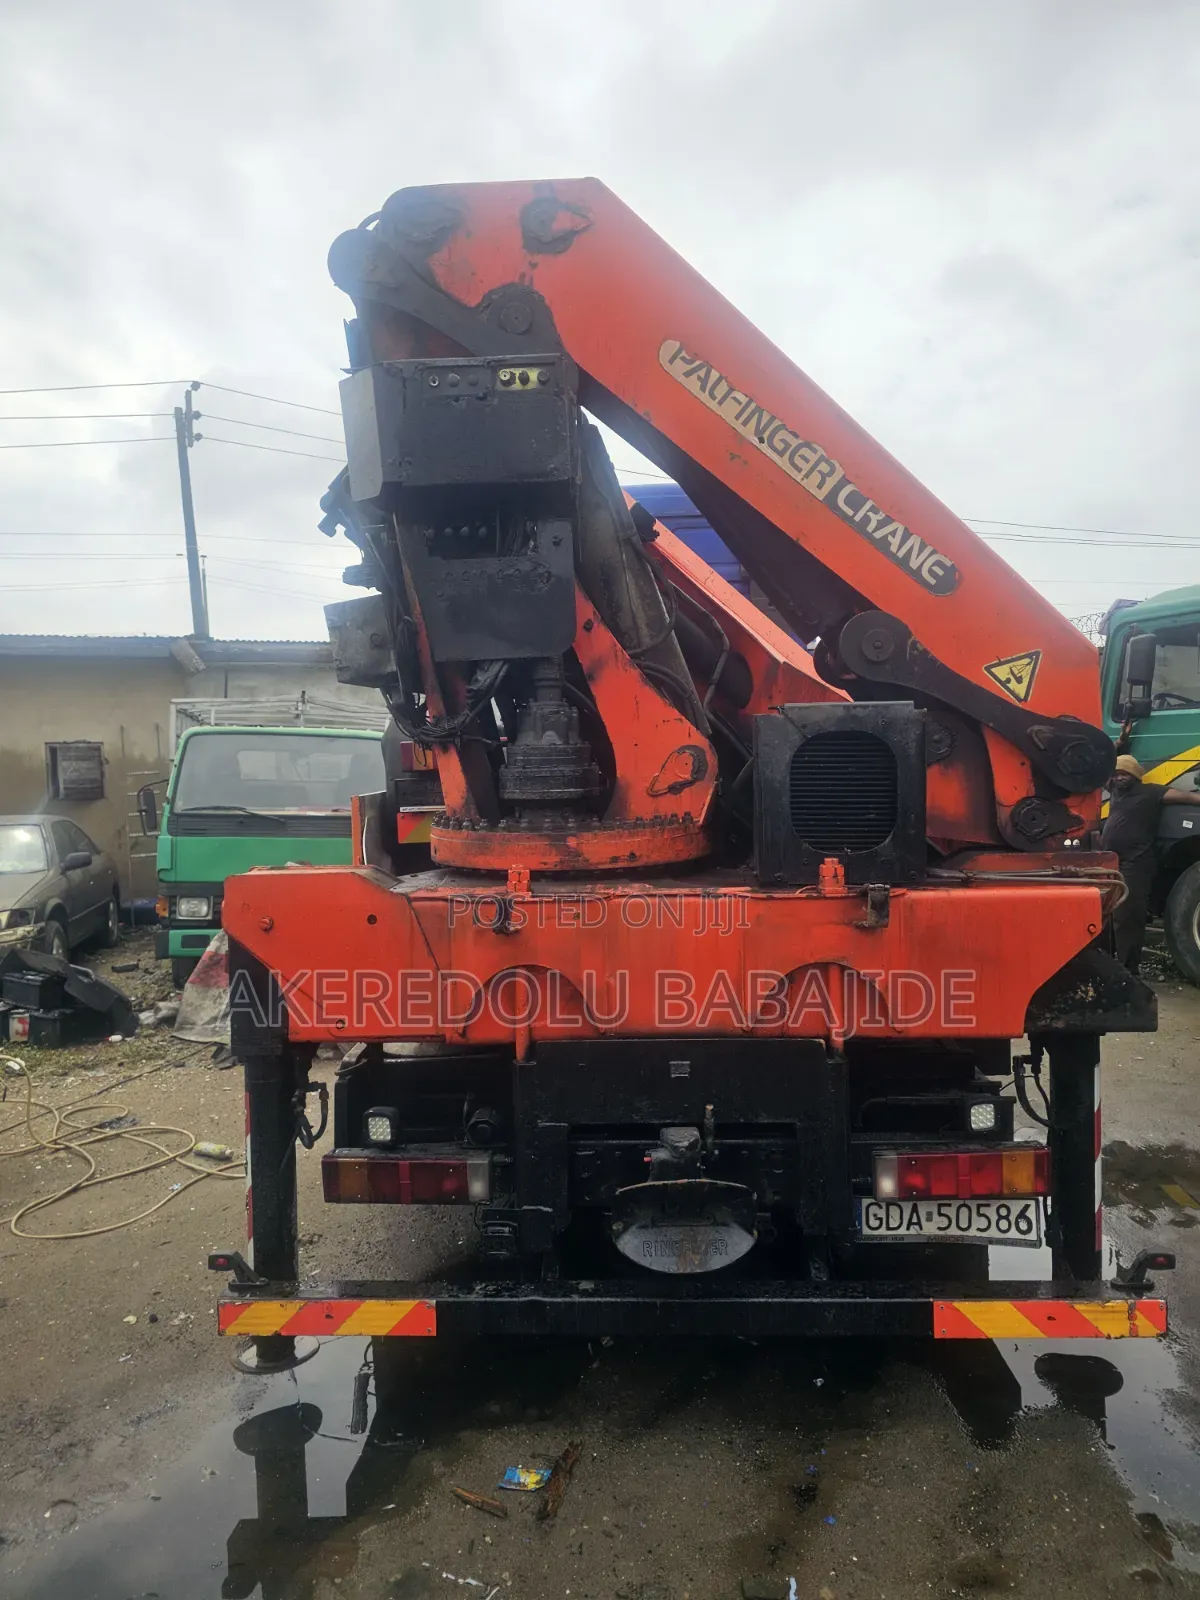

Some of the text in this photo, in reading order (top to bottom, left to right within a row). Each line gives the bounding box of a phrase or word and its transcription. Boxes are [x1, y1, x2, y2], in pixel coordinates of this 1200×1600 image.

[667, 344, 953, 586] PALFINGER CRANE
[864, 1202, 1034, 1236] GDA 50586
